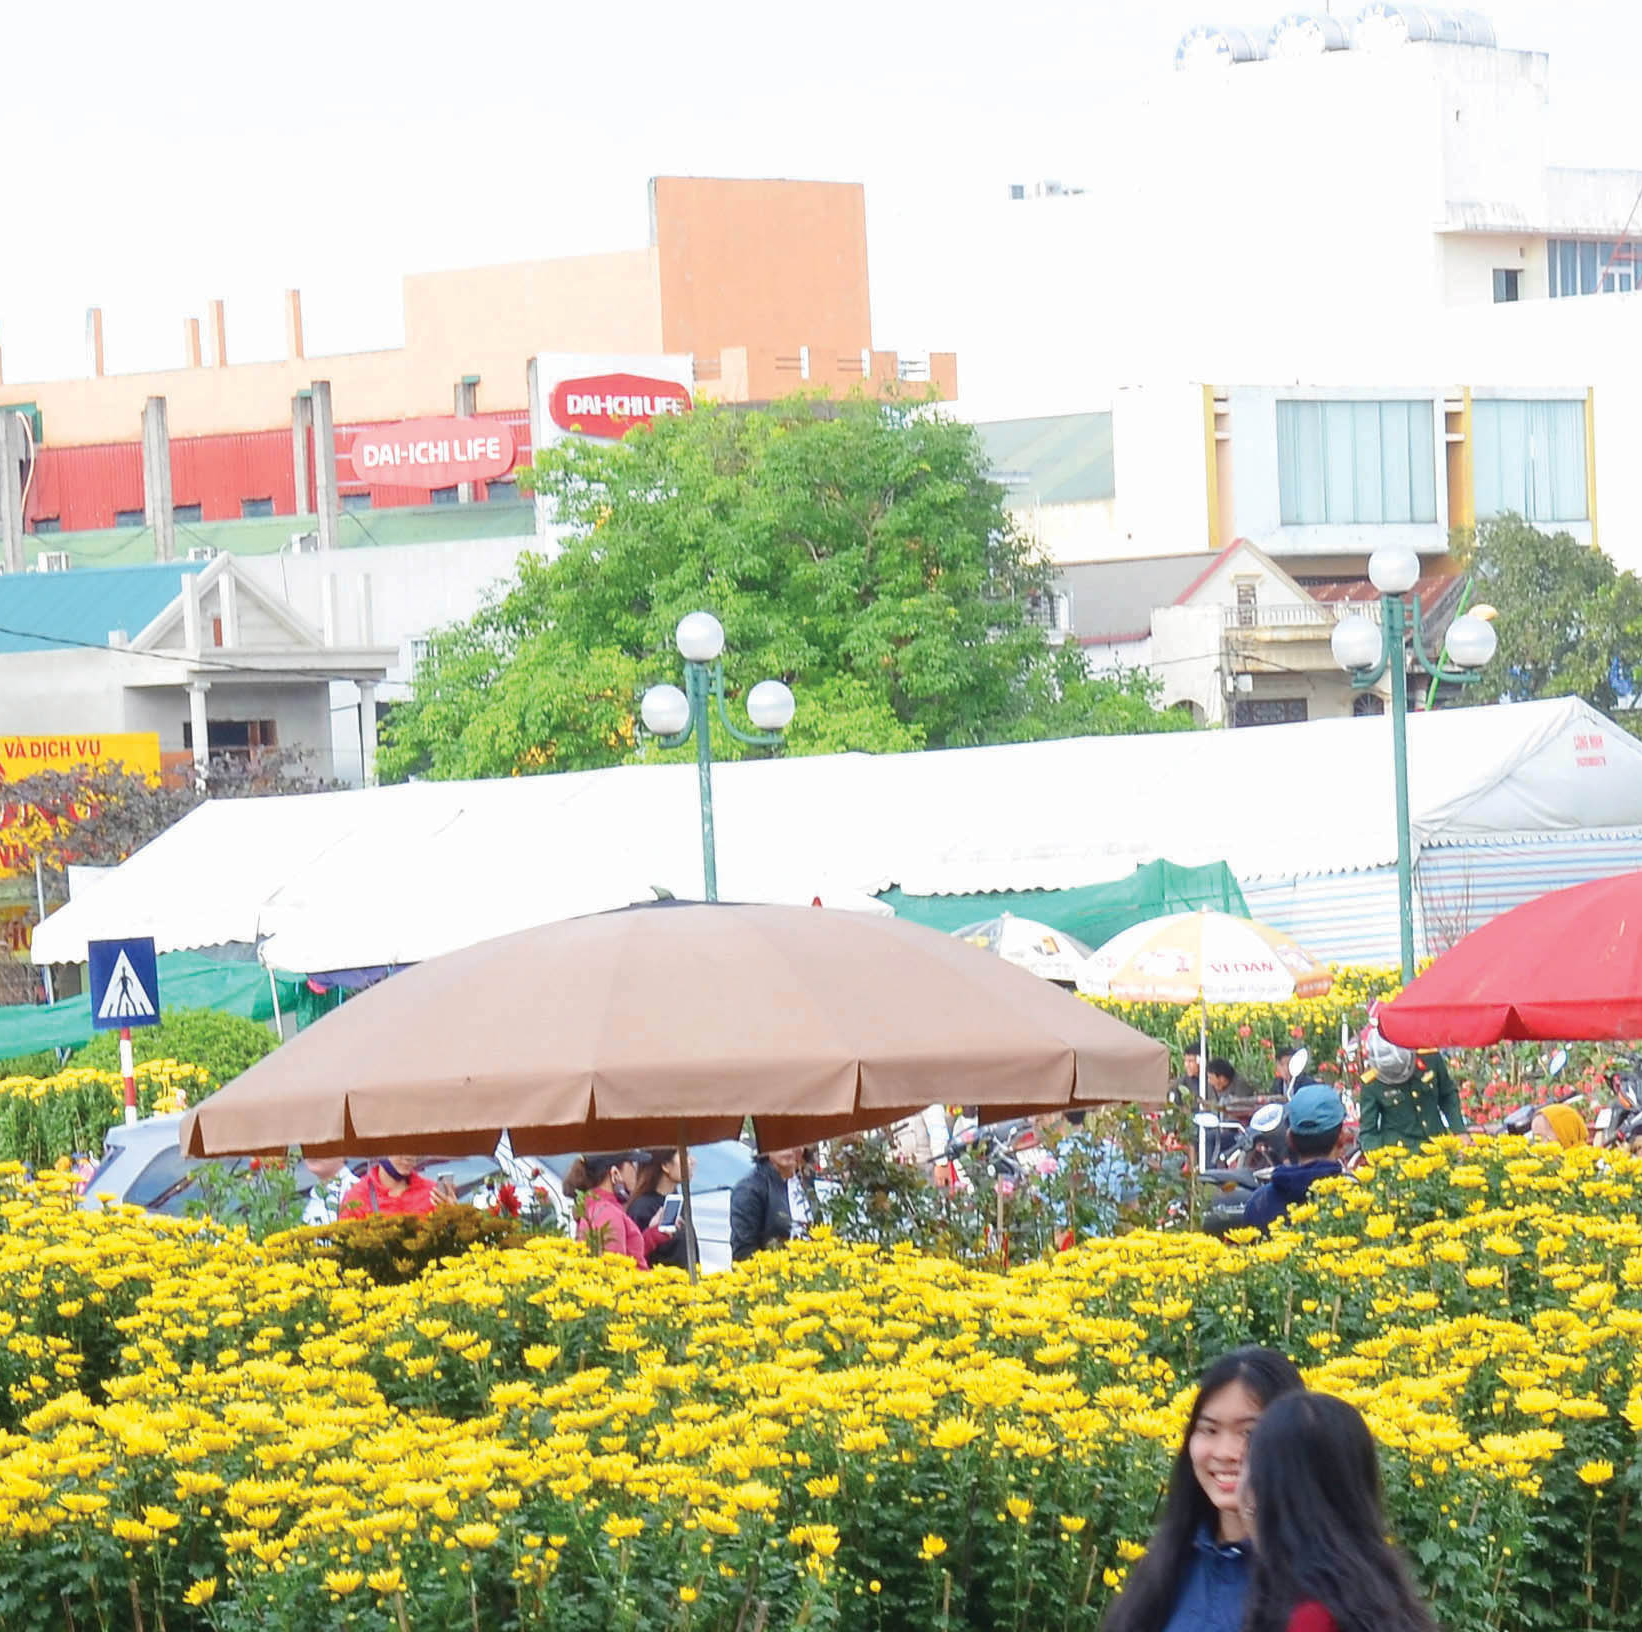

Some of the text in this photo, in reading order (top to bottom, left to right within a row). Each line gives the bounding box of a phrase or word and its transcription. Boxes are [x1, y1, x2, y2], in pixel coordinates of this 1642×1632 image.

[567, 394, 643, 416] DAI-ICHI
[363, 437, 501, 467] DAI-ICHI LIFE
[5, 736, 27, 760] VÀ
[30, 738, 71, 763] DỊCH
[76, 739, 102, 764] VỤ
